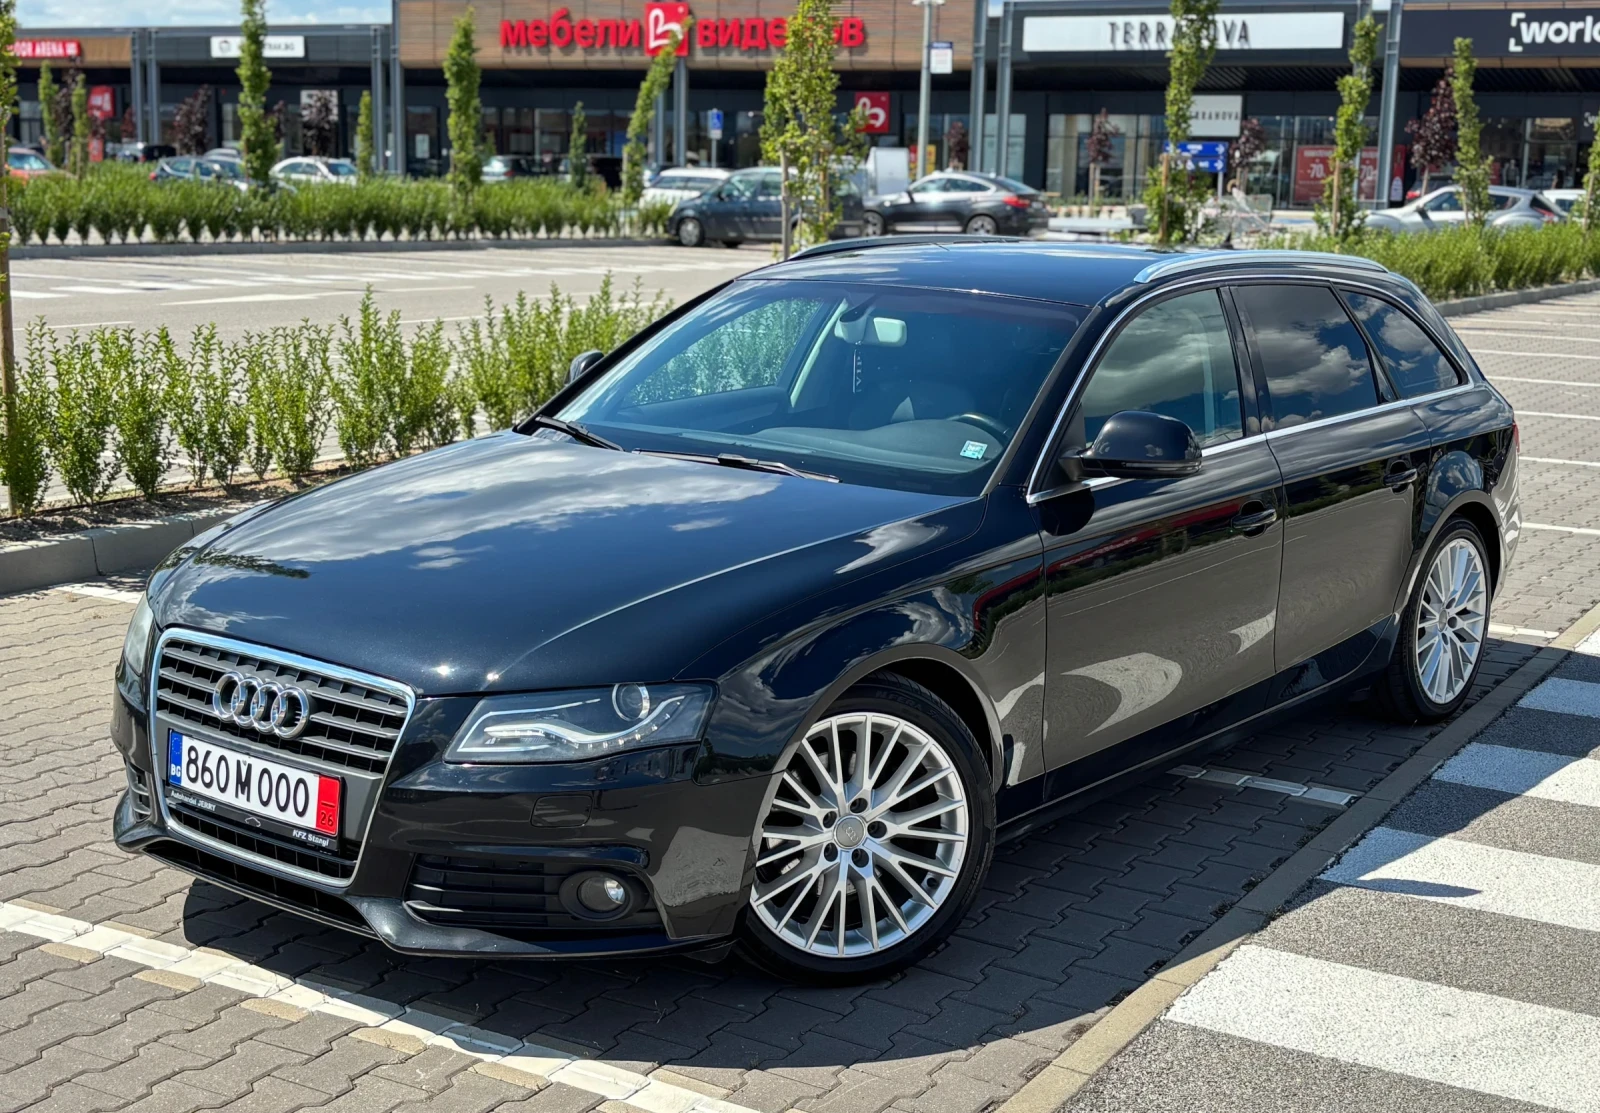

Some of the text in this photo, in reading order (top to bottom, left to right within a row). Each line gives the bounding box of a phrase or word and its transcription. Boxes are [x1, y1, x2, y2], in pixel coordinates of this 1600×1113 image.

[500, 7, 865, 51] мебели видев
[170, 763, 181, 777] BG
[186, 744, 309, 818] 860 M 000
[197, 799, 217, 812] JERRY
[321, 811, 334, 827] 26
[292, 829, 307, 840] KFZ
